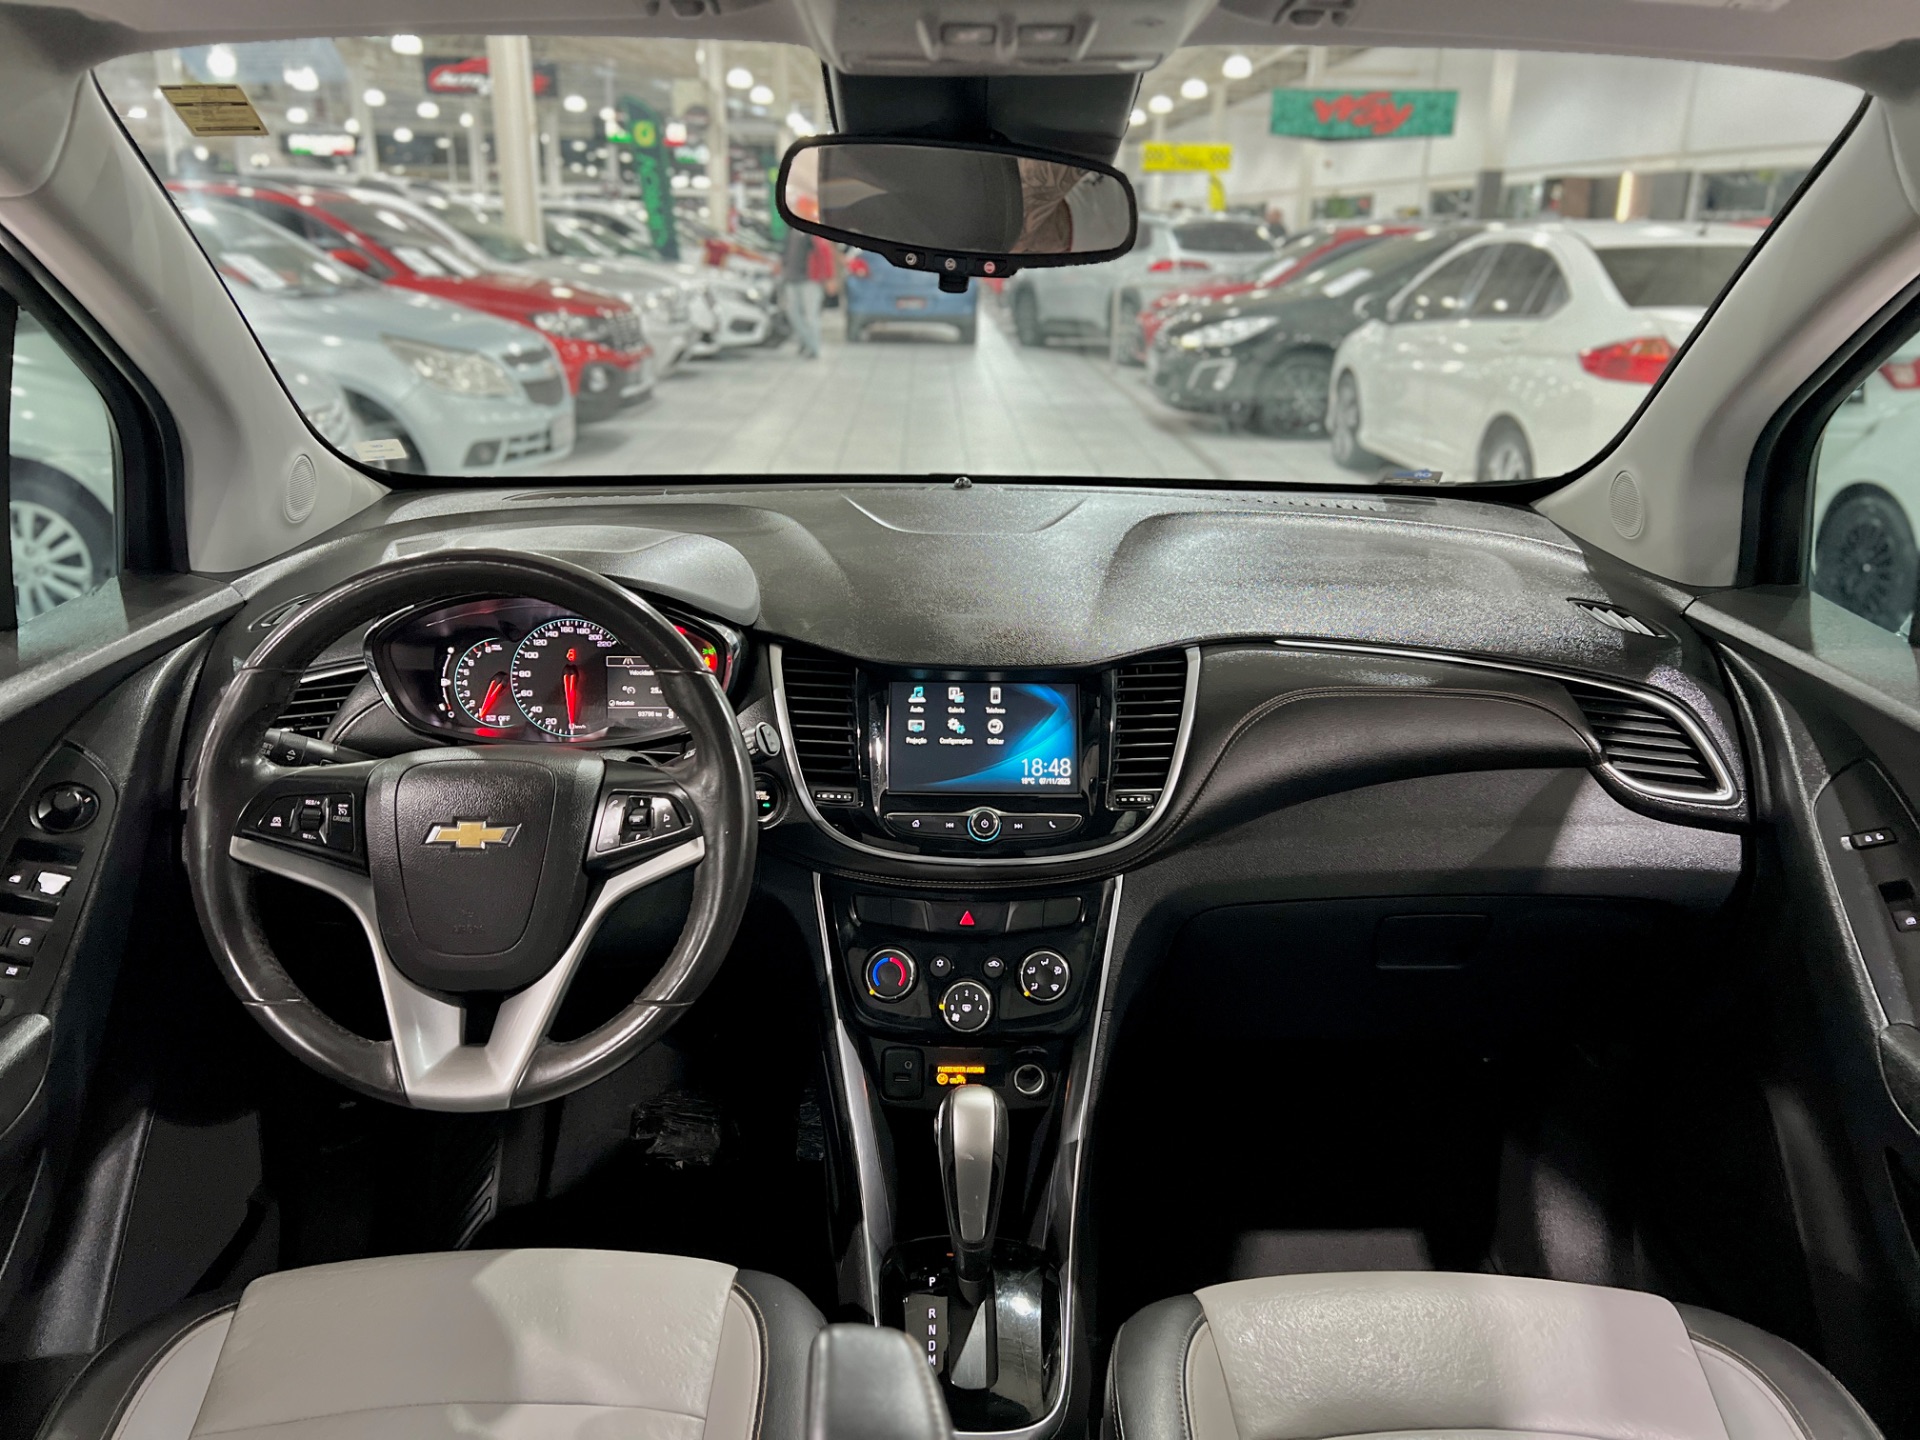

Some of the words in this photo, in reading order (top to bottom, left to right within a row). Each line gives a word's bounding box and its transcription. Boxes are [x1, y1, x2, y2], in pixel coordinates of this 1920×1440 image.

[588, 633, 603, 641] 200
[533, 638, 547, 646] 120
[524, 651, 539, 659] 100
[518, 670, 531, 678] 80
[461, 679, 468, 687] 4
[520, 689, 533, 697] 60
[530, 705, 543, 713] 40
[545, 717, 557, 725] 20
[1021, 758, 1072, 776] 18:48
[928, 1276, 936, 1287] P
[928, 1308, 937, 1319] R
[928, 1324, 936, 1336] N
[928, 1340, 936, 1352] D
[928, 1354, 936, 1366] M
